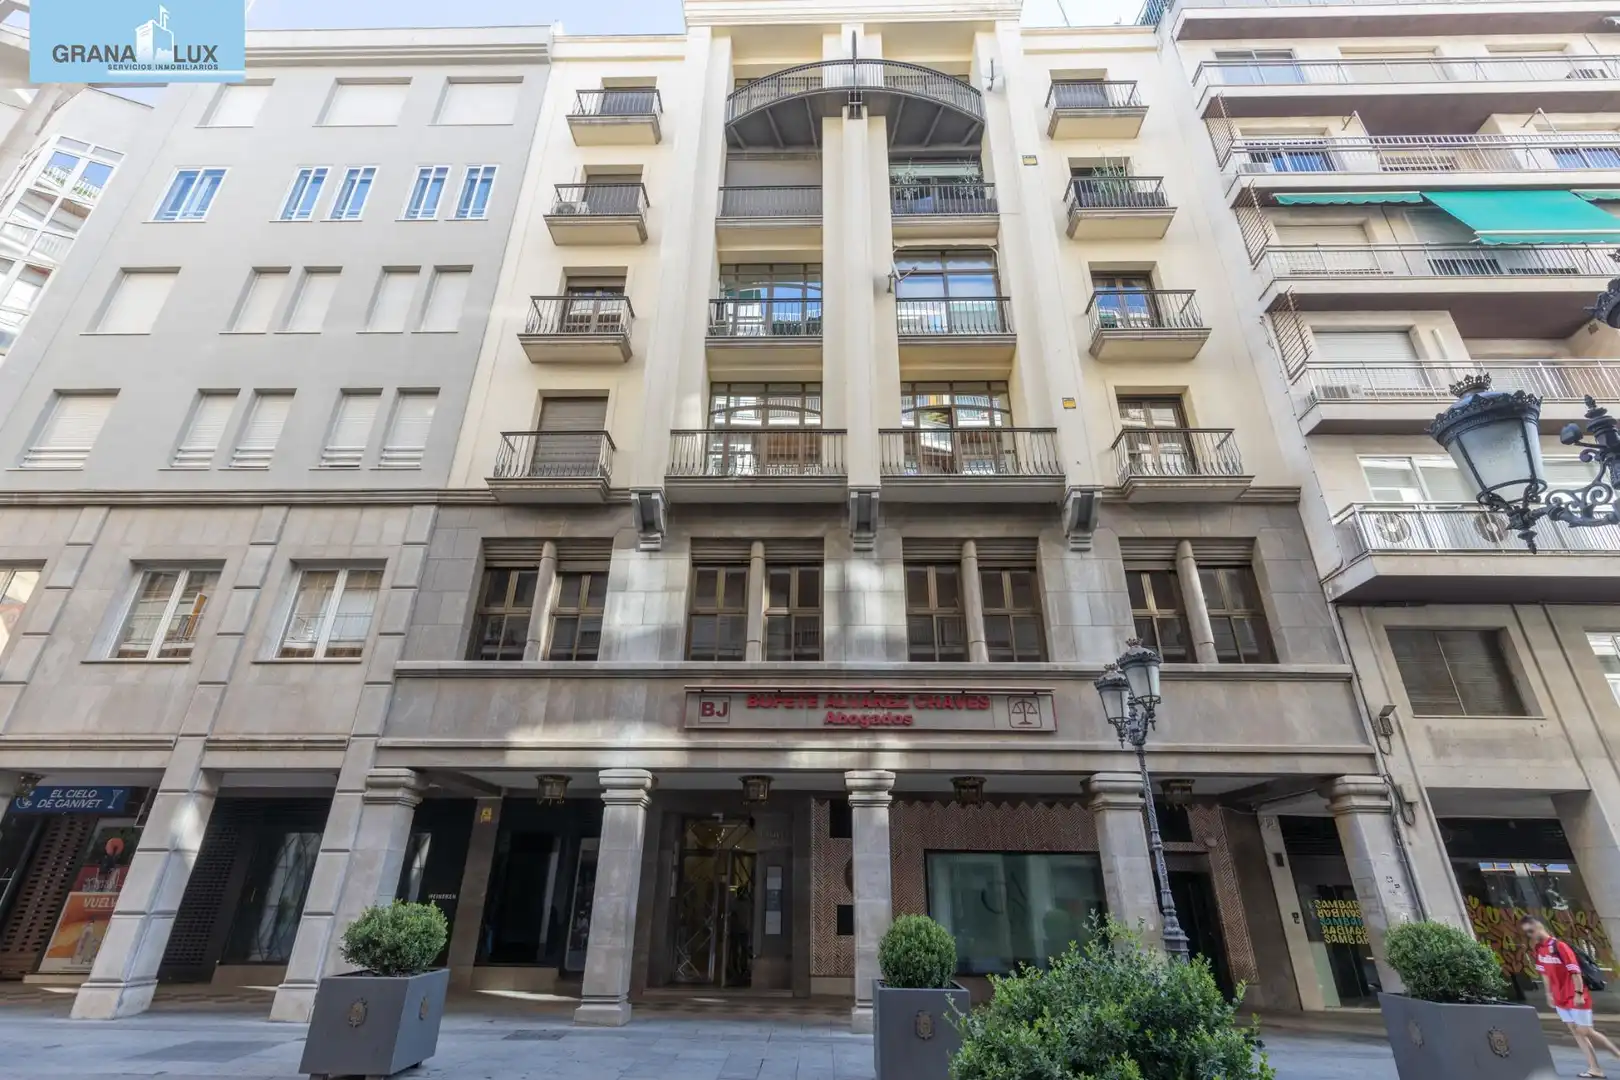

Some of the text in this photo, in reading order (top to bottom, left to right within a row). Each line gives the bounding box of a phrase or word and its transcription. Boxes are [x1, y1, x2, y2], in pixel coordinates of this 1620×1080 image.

[701, 701, 728, 718] BJ
[746, 694, 818, 709] BUFETE
[913, 694, 990, 710] CHAVES
[823, 711, 912, 728] Abogados
[50, 789, 97, 798] EL CIELO
[37, 799, 103, 808] DE GANIVET
